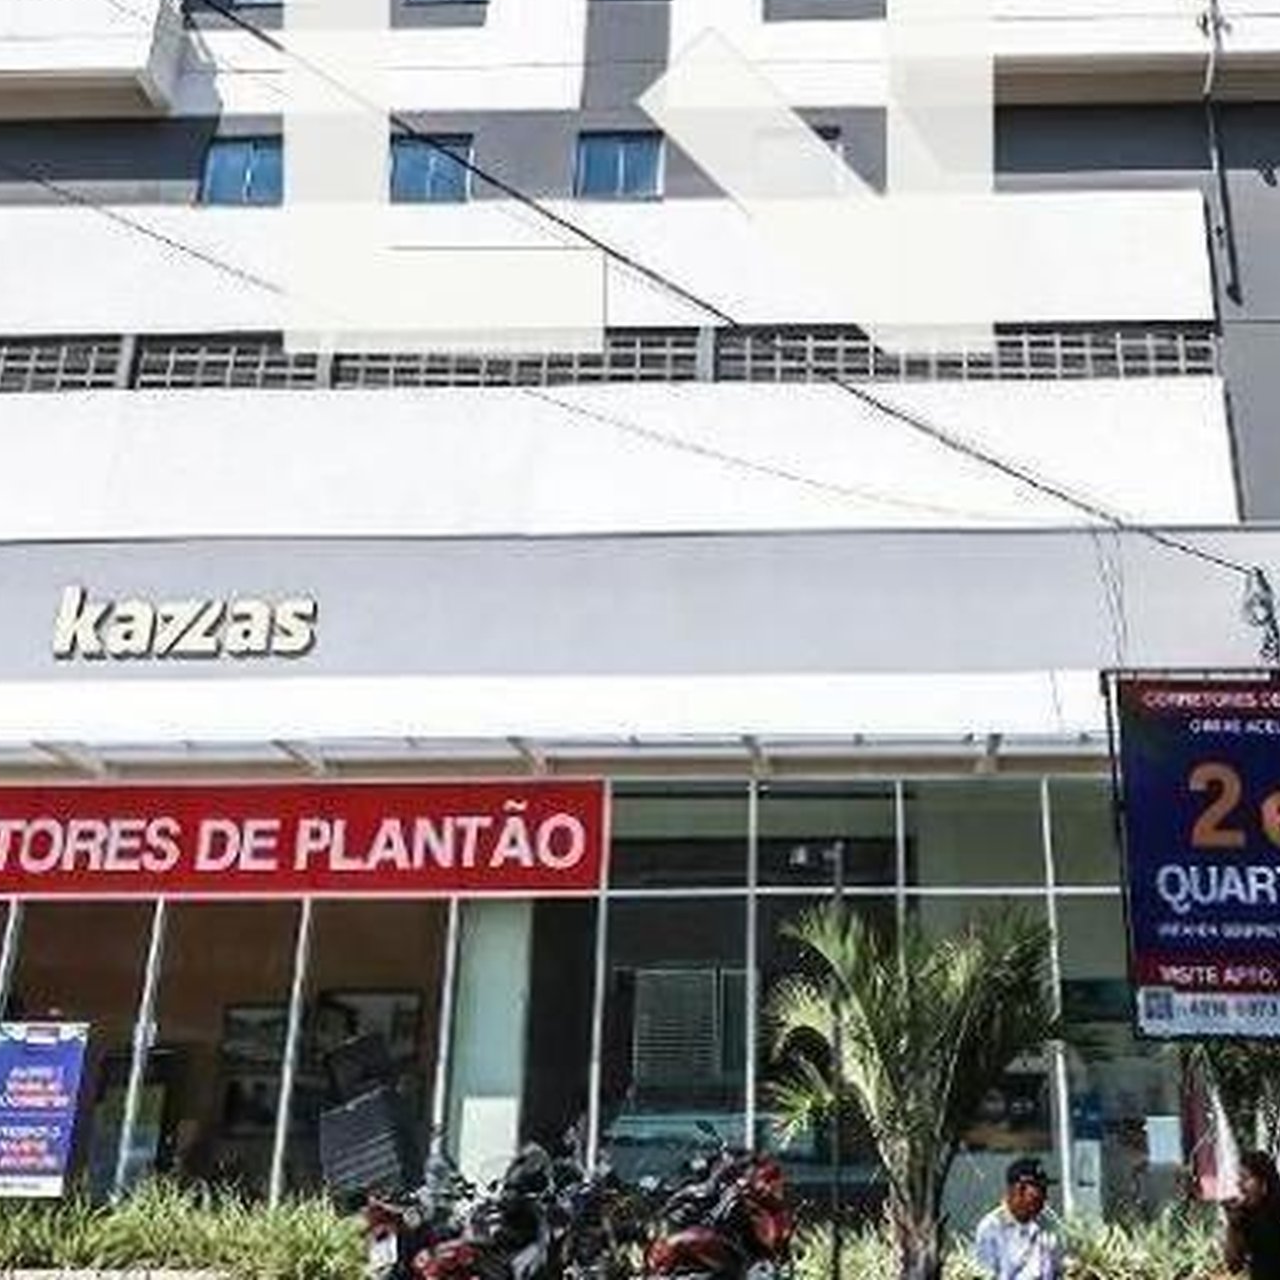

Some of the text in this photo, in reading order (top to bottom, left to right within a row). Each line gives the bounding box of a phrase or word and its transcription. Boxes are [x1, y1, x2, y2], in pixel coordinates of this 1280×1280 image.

[196, 816, 278, 872] DE
[295, 799, 586, 872] PLANTÃO
[1188, 761, 1246, 848] 2
